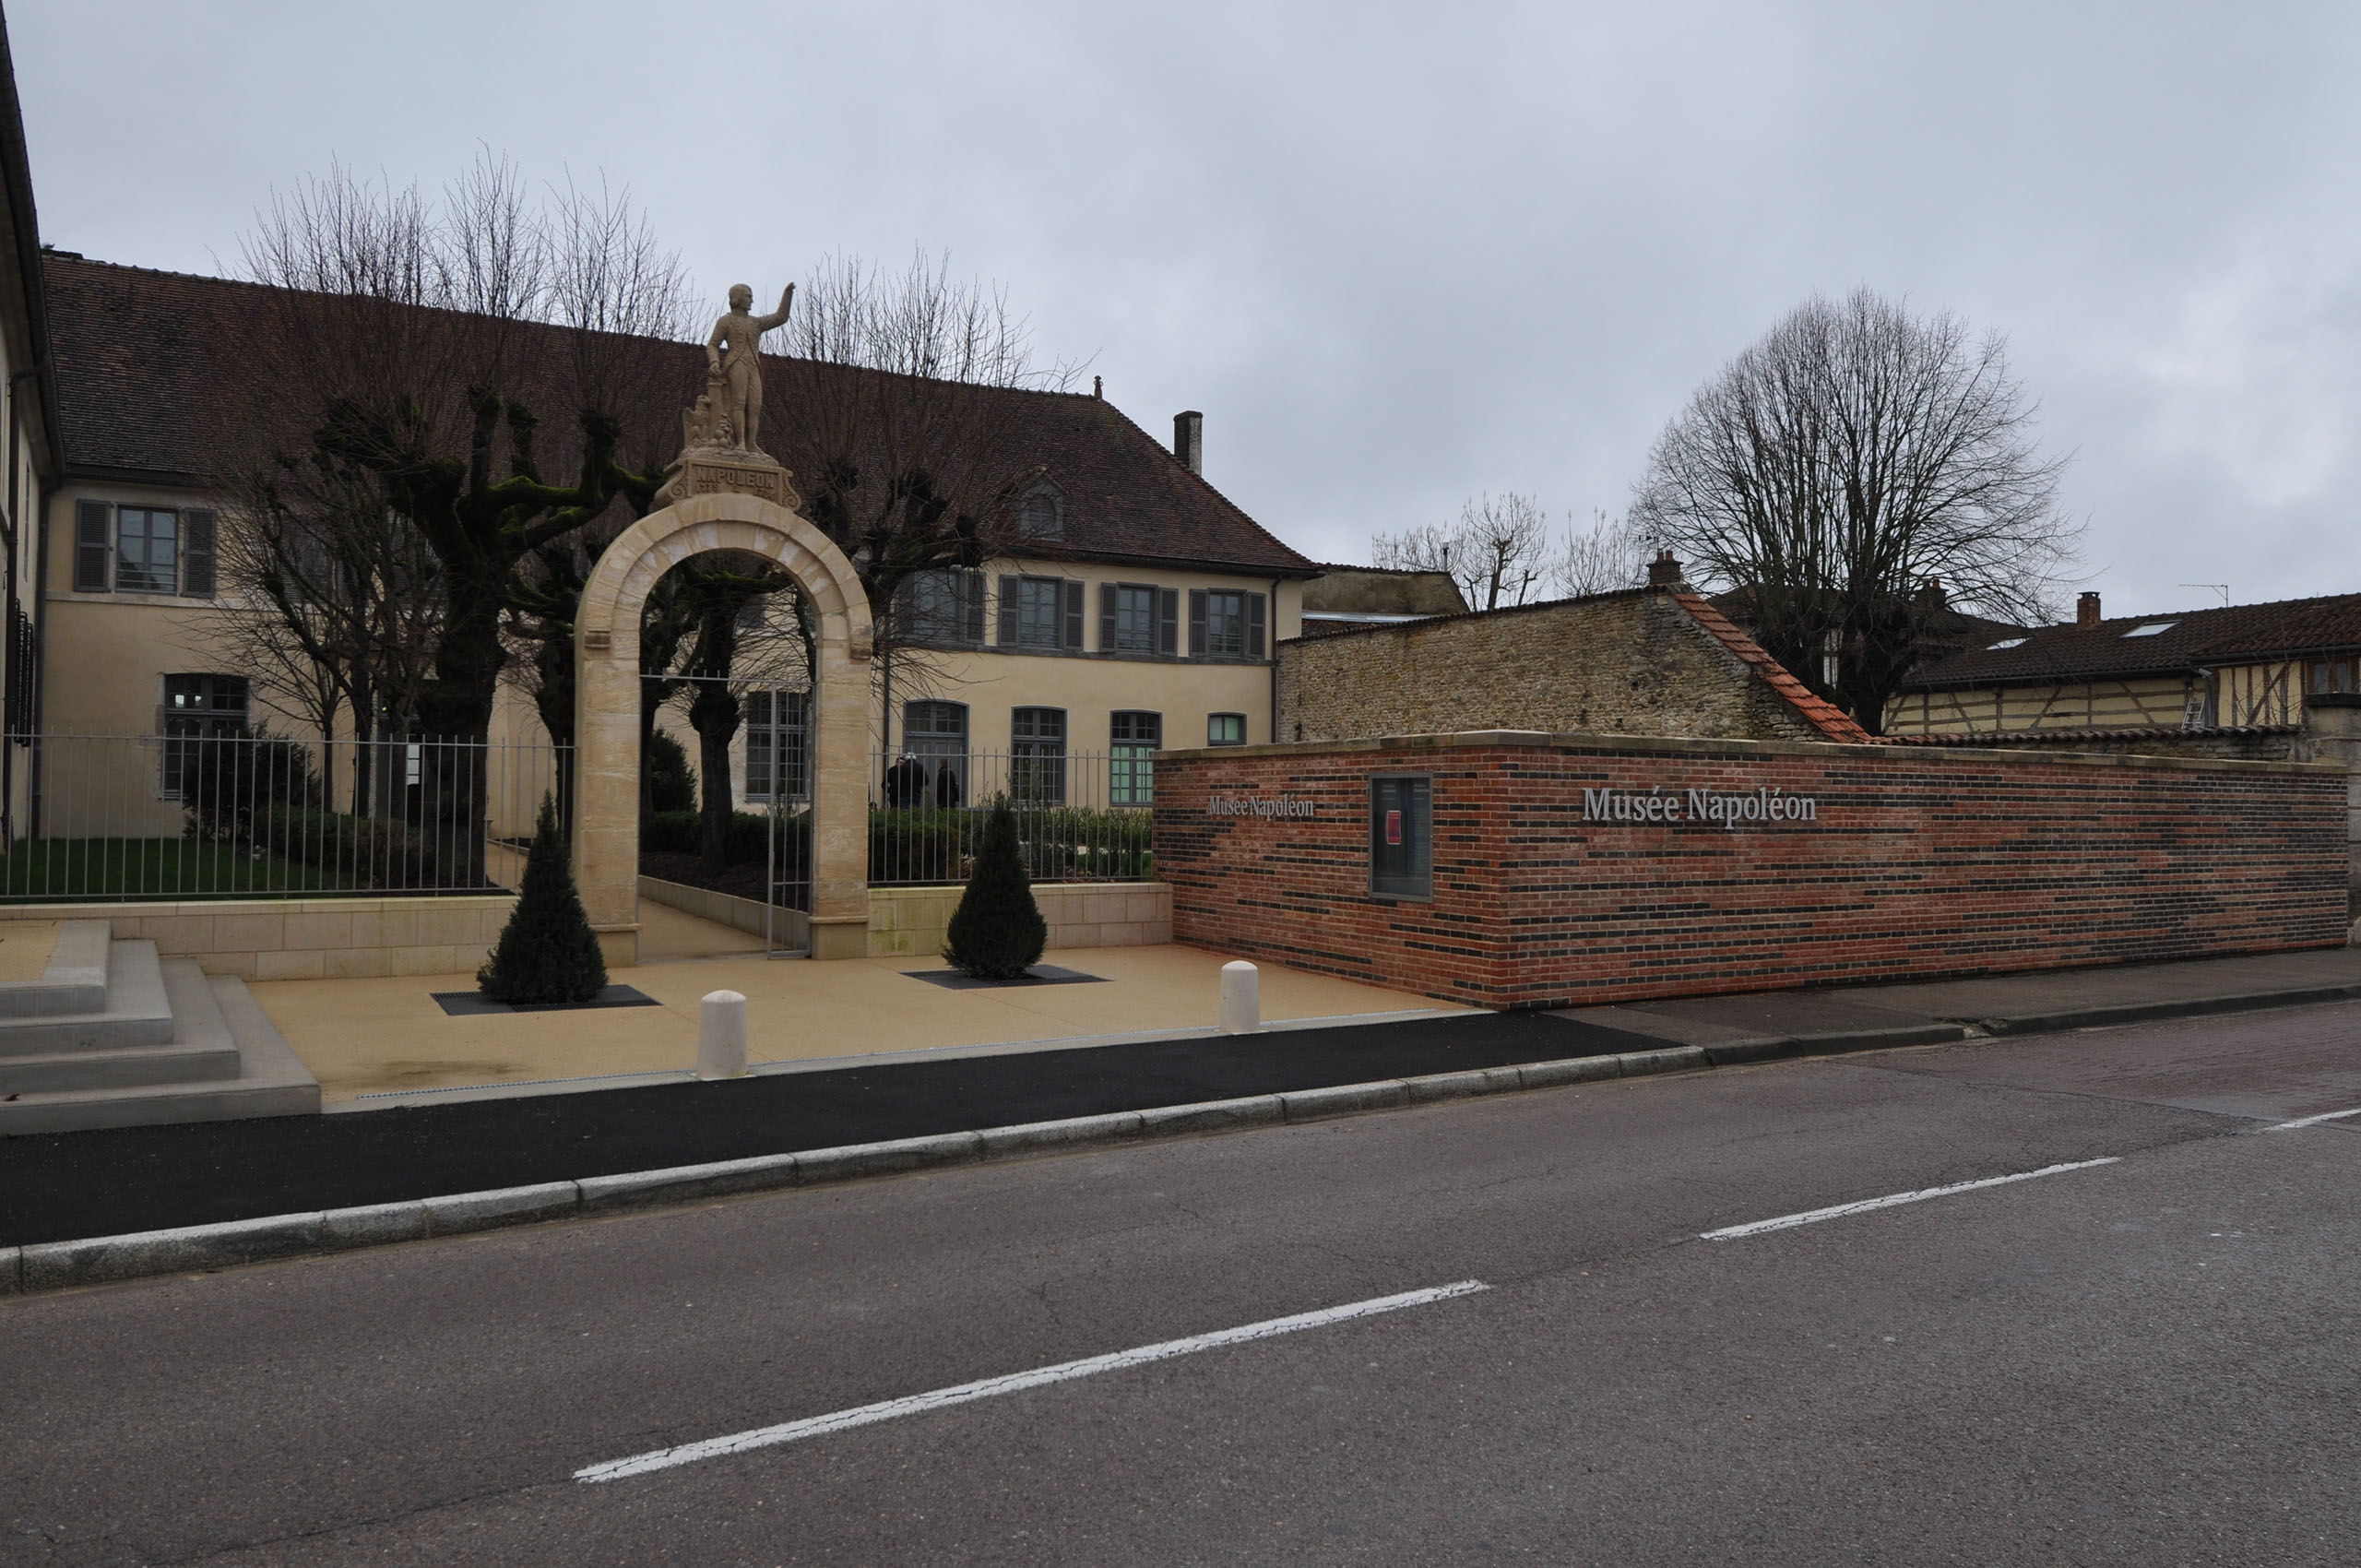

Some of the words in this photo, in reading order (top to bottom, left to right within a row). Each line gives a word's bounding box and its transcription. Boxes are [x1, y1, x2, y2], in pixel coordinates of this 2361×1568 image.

[696, 467, 774, 488] NAPOLEON
[1209, 793, 1248, 816] Musée
[1249, 793, 1314, 822] Napoléon
[1583, 785, 1679, 821] Musée
[1687, 787, 1817, 830] Napoléon
